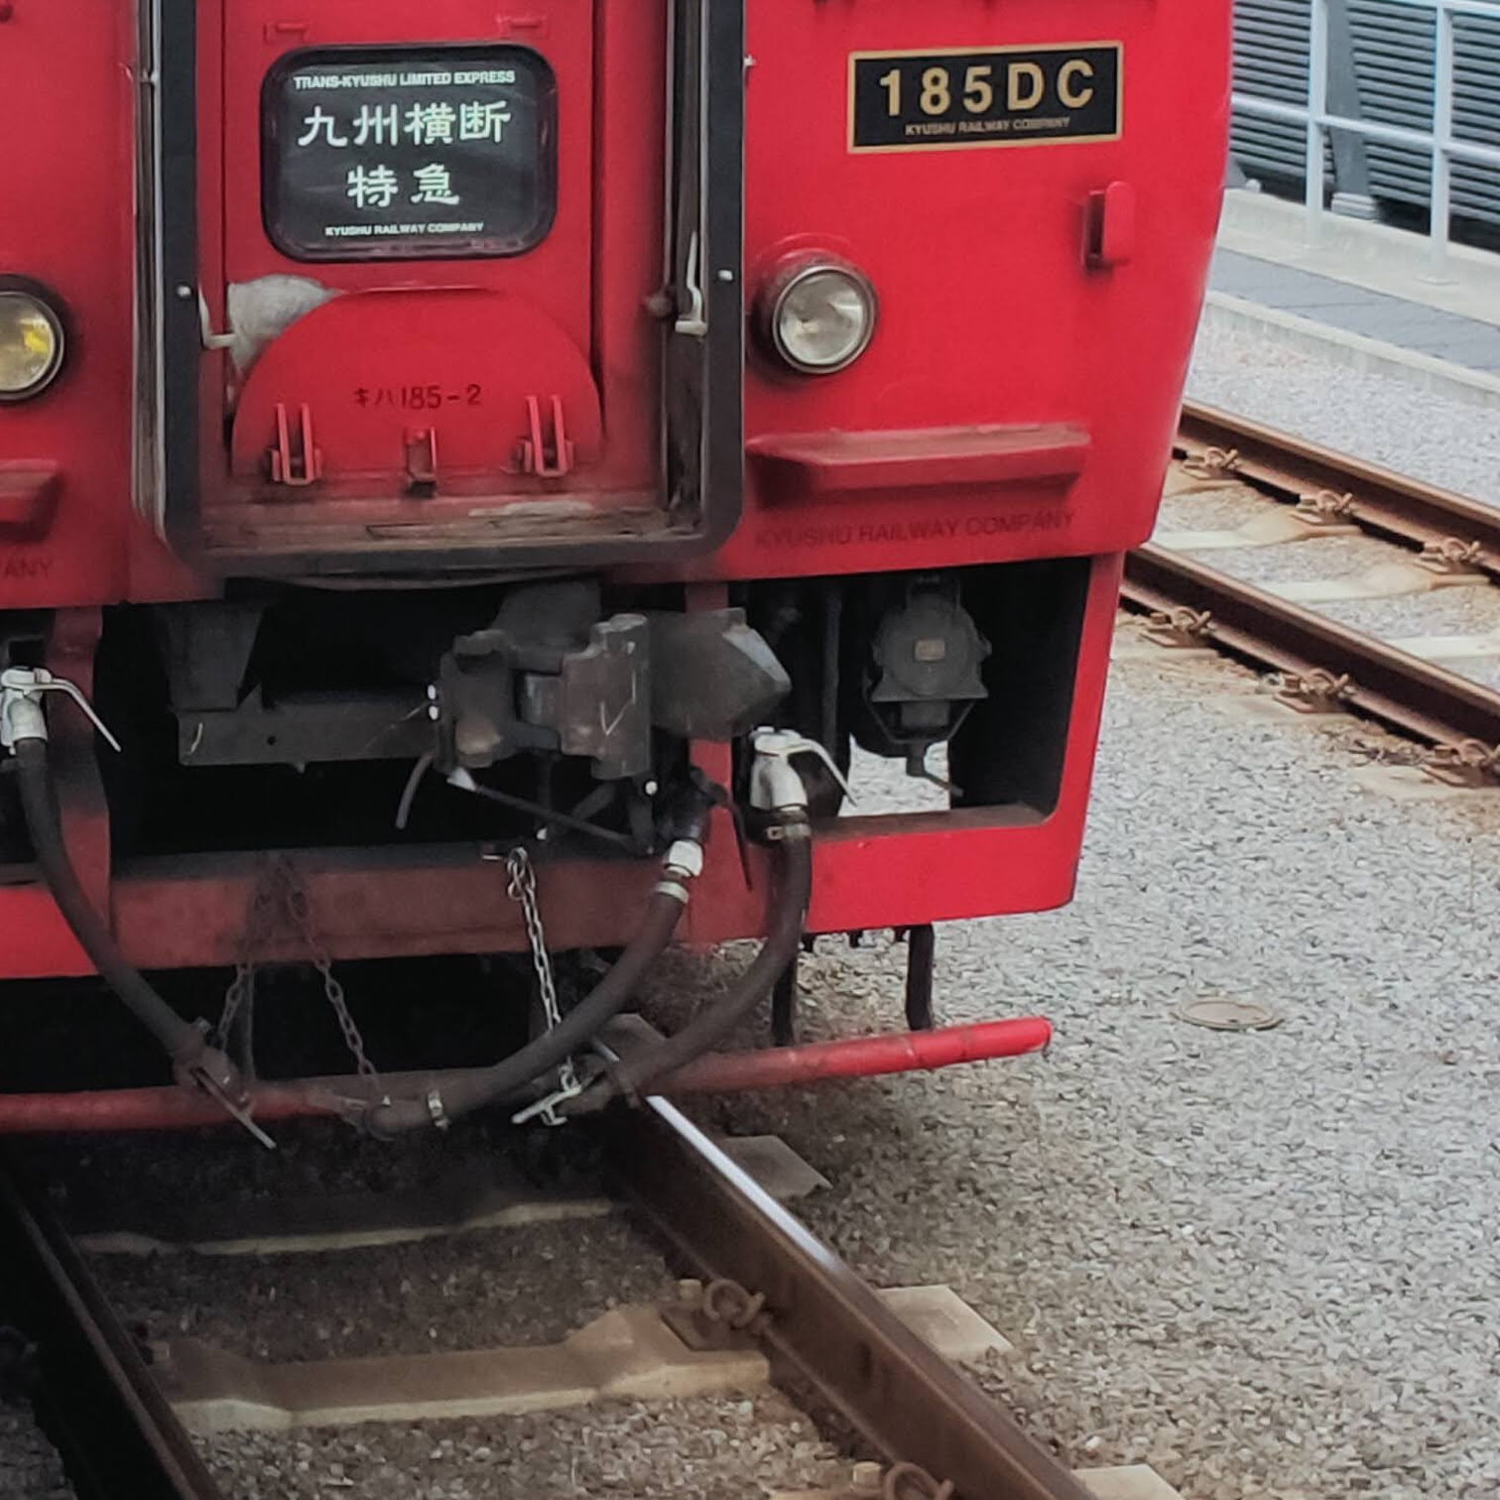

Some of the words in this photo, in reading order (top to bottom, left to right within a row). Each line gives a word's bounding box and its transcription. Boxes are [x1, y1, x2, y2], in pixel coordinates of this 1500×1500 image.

[293, 73, 398, 89] TRANS-KYUSHU
[400, 72, 452, 86] LIMITED
[453, 70, 516, 85] EXPRESS
[880, 58, 1094, 117] 185DC
[297, 100, 512, 147] 九州横断
[905, 120, 957, 136] KYUSHU
[958, 118, 1012, 134] RAILWAY
[1013, 116, 1071, 132] COMPANY
[346, 163, 461, 208] 特急
[325, 225, 373, 237] KYUSHU
[374, 224, 426, 236] RAILWAY
[427, 222, 484, 234] COMPANY
[354, 383, 482, 410] キハ185-2
[755, 525, 852, 547] KYUSHU
[858, 520, 960, 543] RAILWAY
[965, 512, 1075, 537] COMPANY
